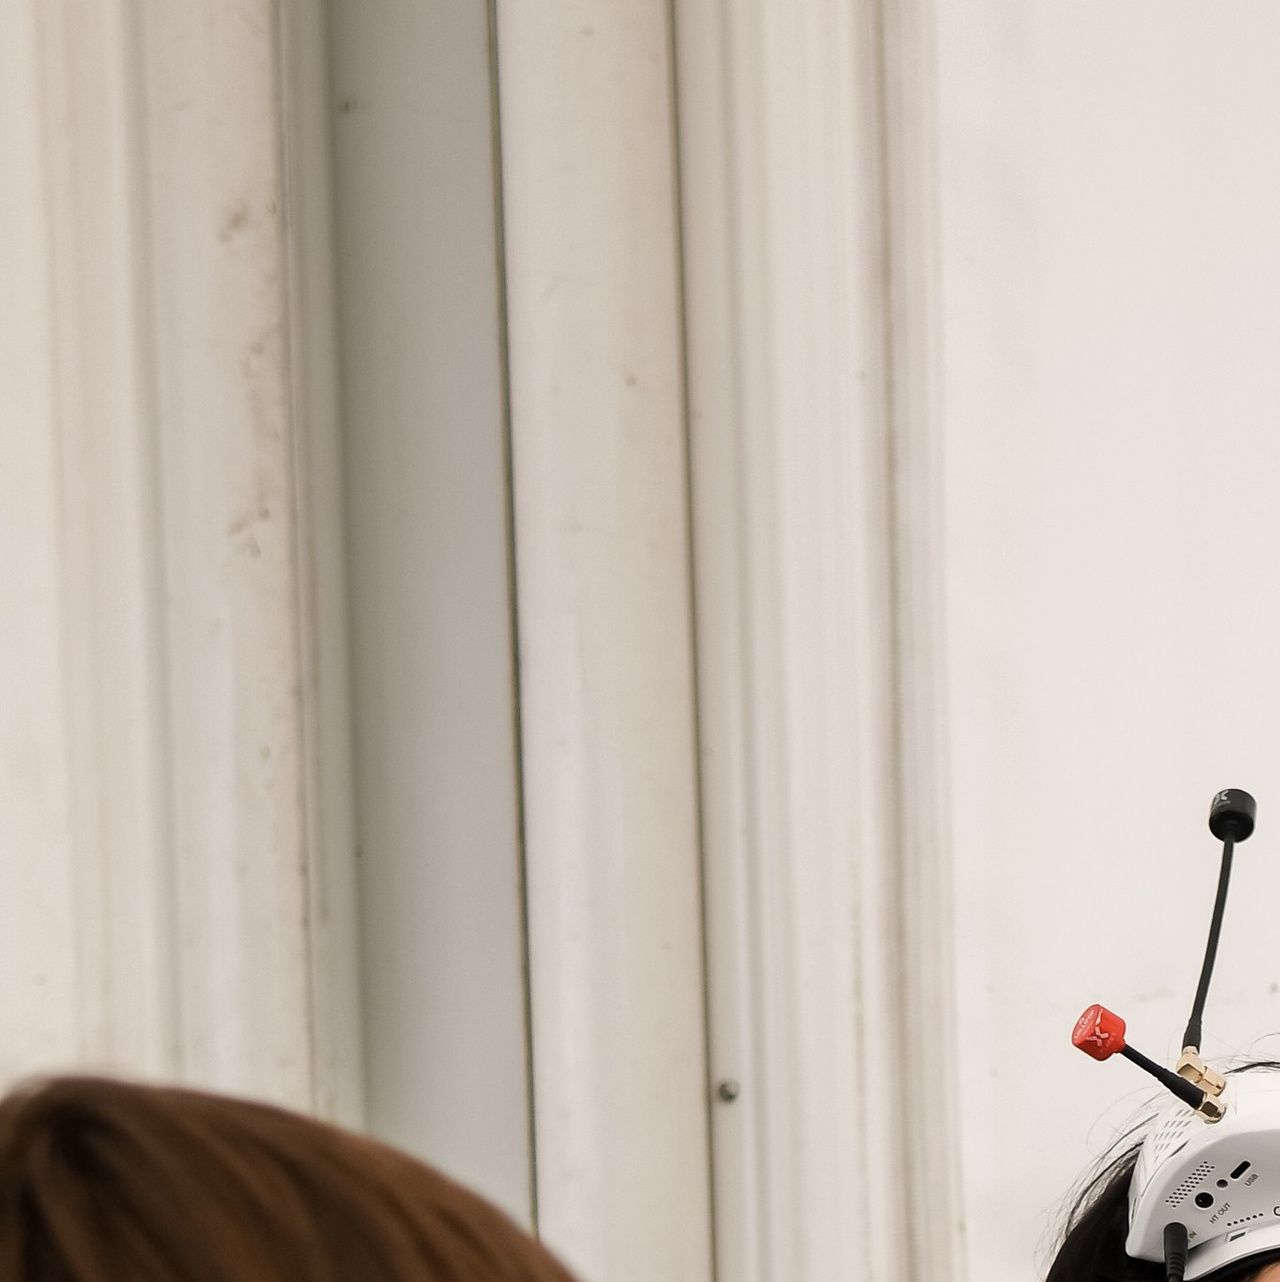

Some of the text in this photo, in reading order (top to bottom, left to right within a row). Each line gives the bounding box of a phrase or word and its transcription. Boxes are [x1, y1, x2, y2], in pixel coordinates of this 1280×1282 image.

[1244, 1173, 1259, 1187] USB
[1209, 1202, 1231, 1225] HT OUT
